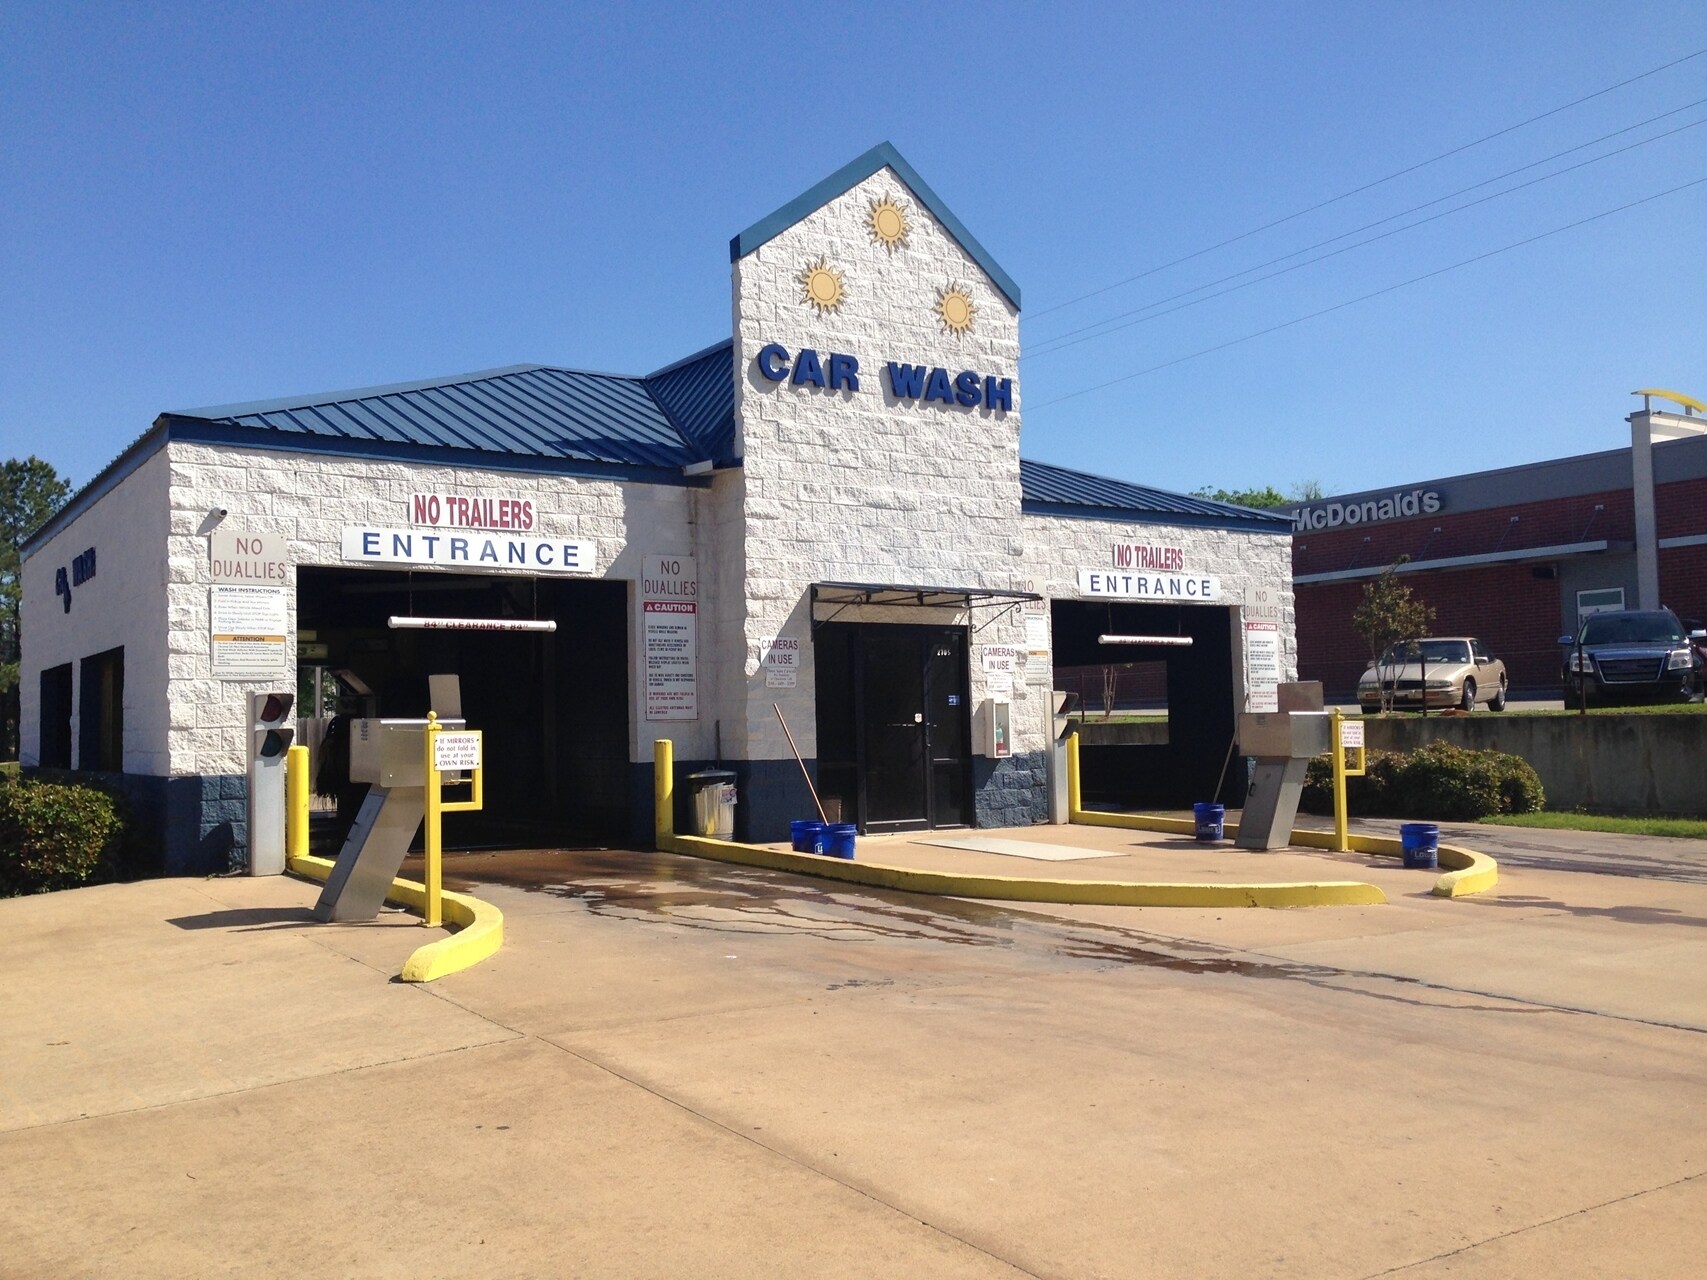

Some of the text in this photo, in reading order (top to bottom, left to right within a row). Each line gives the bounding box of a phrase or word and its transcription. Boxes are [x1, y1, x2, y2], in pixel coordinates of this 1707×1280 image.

[758, 343, 1012, 411] CAR WASH
[414, 494, 533, 530] NO TRAILERS
[1291, 490, 1441, 531] McDonald's
[236, 537, 263, 555] NO
[362, 532, 579, 567] ENTRANCE
[1117, 544, 1184, 571] NO TRAILERS
[213, 560, 286, 579] DUALLIES
[660, 560, 680, 575] NO
[644, 579, 696, 596] DUALLIES
[1090, 574, 1211, 597] ENTRANCE
[1255, 590, 1268, 603] NO
[654, 603, 693, 612] CAUTION
[1246, 604, 1279, 618] DUALLIES
[445, 620, 506, 630] CLEARANCE
[761, 639, 799, 650] CAMERAS
[983, 647, 1015, 657] CAMERAS
[768, 654, 793, 665] IN USE
[988, 660, 1010, 670] IN USE
